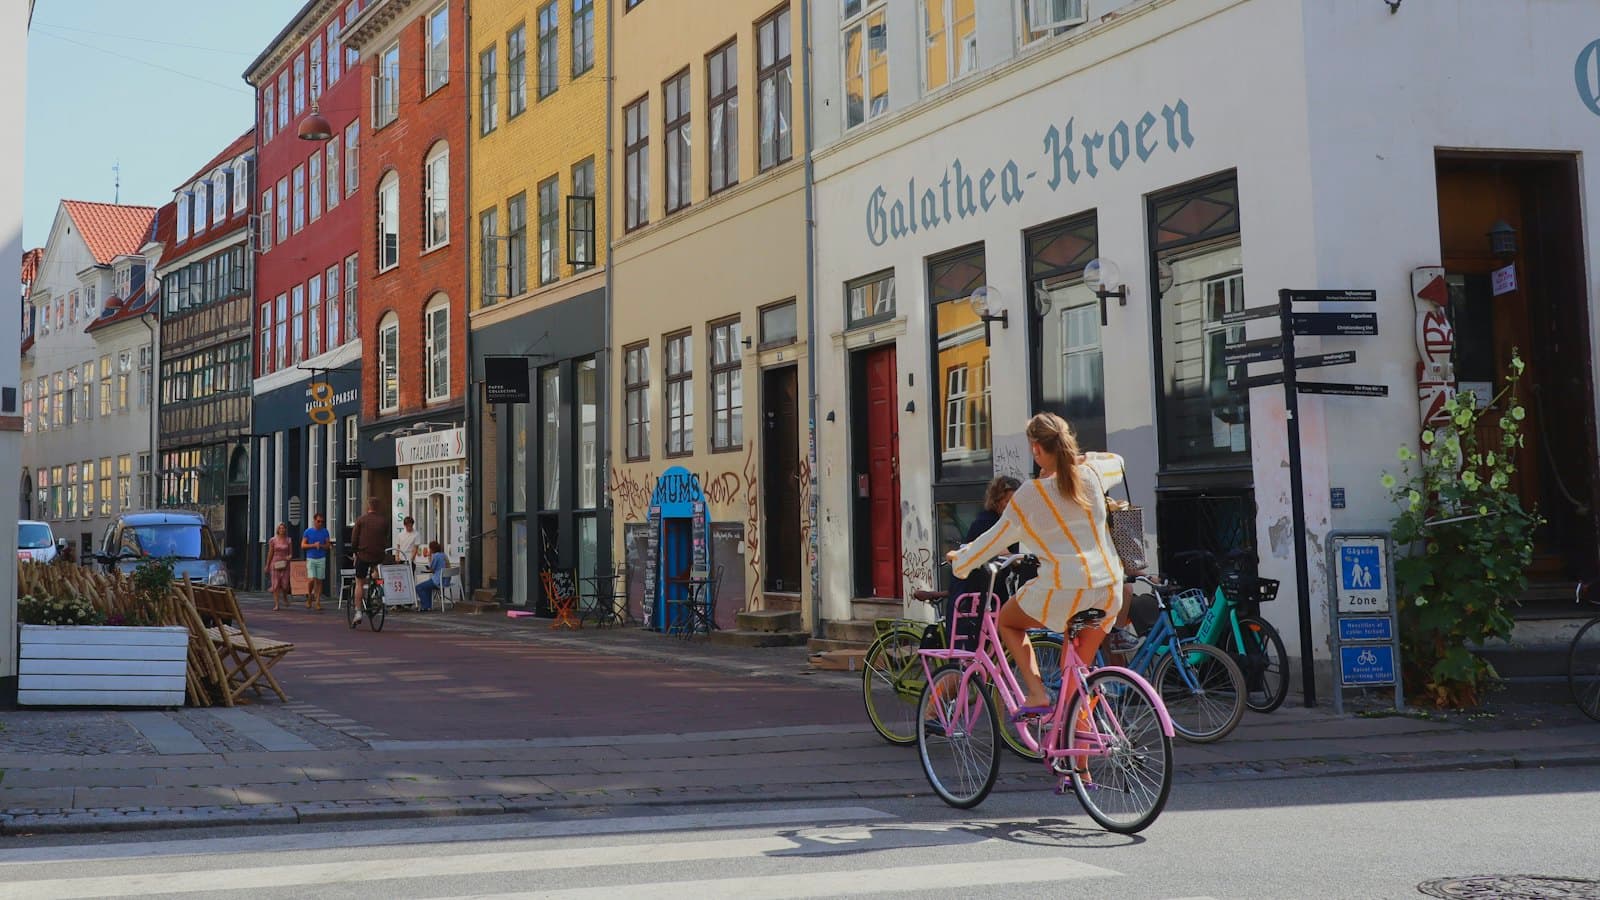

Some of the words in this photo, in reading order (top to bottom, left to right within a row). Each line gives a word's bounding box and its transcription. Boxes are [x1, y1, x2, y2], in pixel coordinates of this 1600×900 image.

[655, 473, 700, 504] MUMS
[396, 482, 404, 533] PAST
[456, 475, 465, 553] SANDWICH
[1350, 595, 1377, 605] Zone
[1198, 612, 1216, 640] IER
